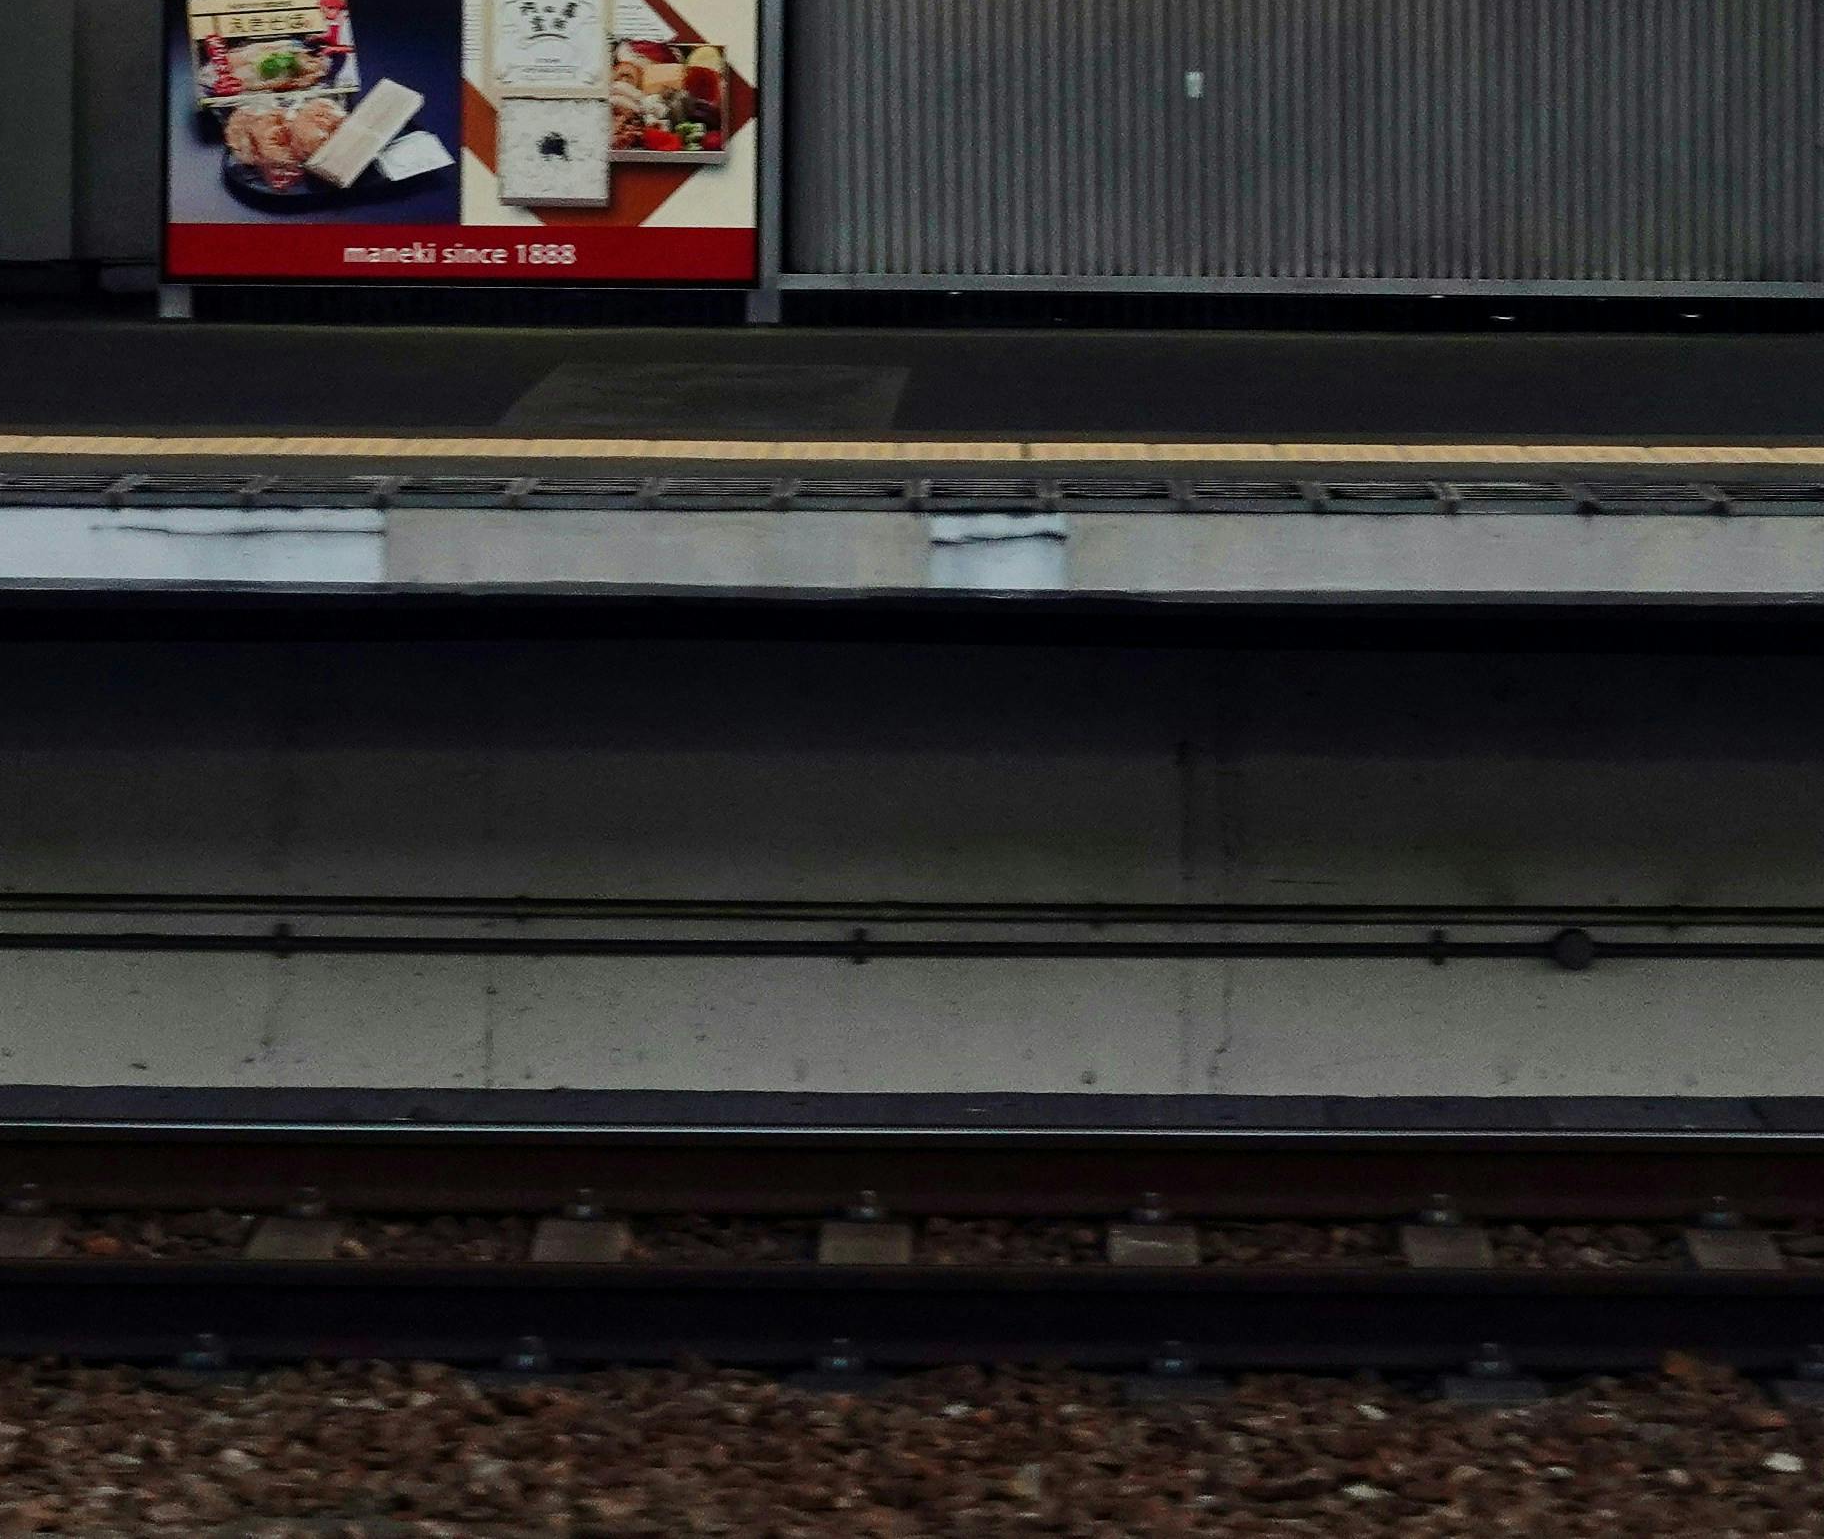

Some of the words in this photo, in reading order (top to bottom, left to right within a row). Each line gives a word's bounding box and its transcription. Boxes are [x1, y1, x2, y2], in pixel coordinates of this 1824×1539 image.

[343, 241, 436, 265] maneki
[442, 242, 508, 265] since
[515, 243, 577, 266] 1888
